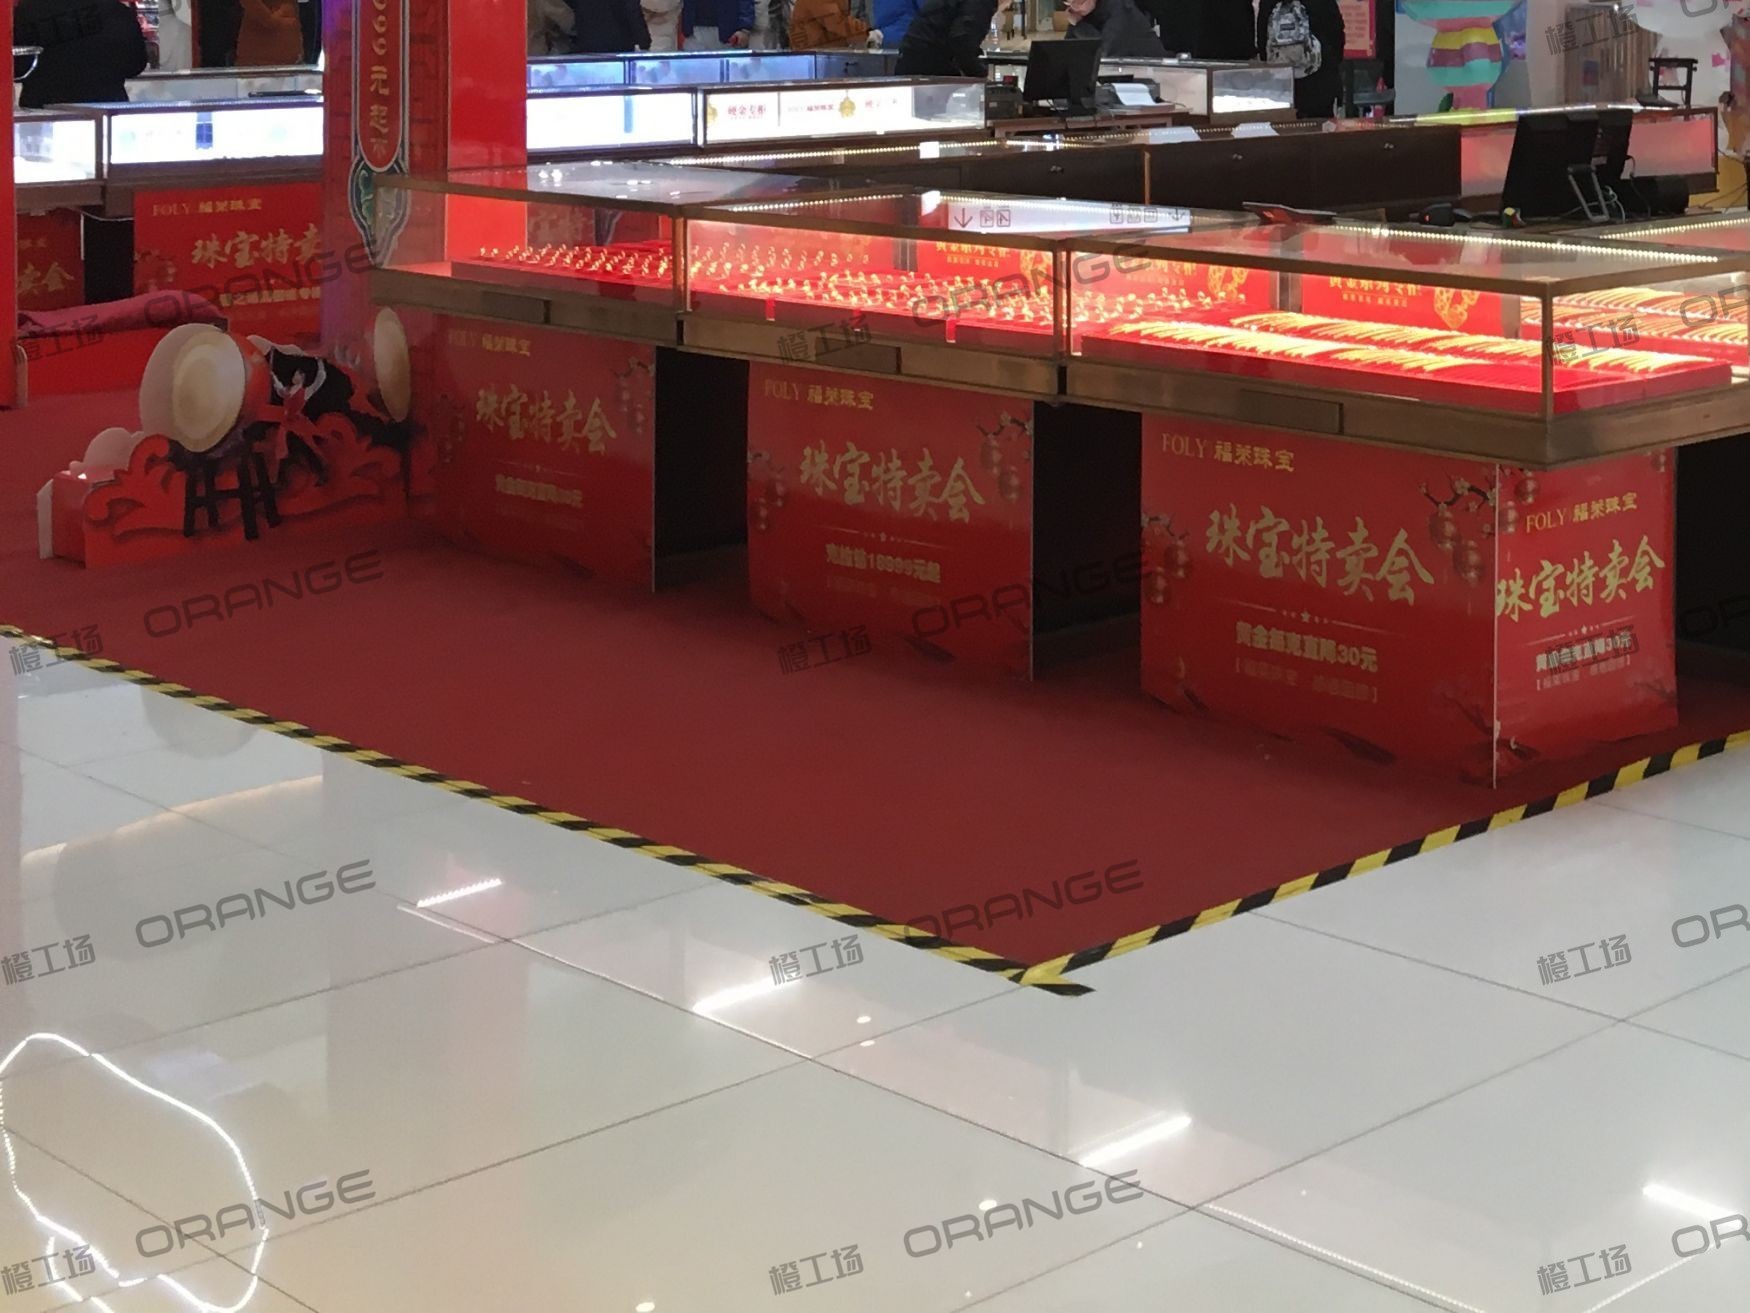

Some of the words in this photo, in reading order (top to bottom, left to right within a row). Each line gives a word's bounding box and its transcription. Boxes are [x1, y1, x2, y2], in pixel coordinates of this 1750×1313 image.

[476, 383, 617, 455] 珠宝特卖会
[806, 384, 875, 410] 福莱珠宝
[799, 439, 986, 524] 珠宝特卖会
[1161, 433, 1207, 459] FOLY
[1214, 439, 1295, 473] 福莱珠宝
[1525, 508, 1568, 534] FOLY
[1573, 491, 1638, 523] 福莱珠宝
[1205, 502, 1435, 607] 珠宝特卖会
[1495, 535, 1666, 624] 珠宝特卖会
